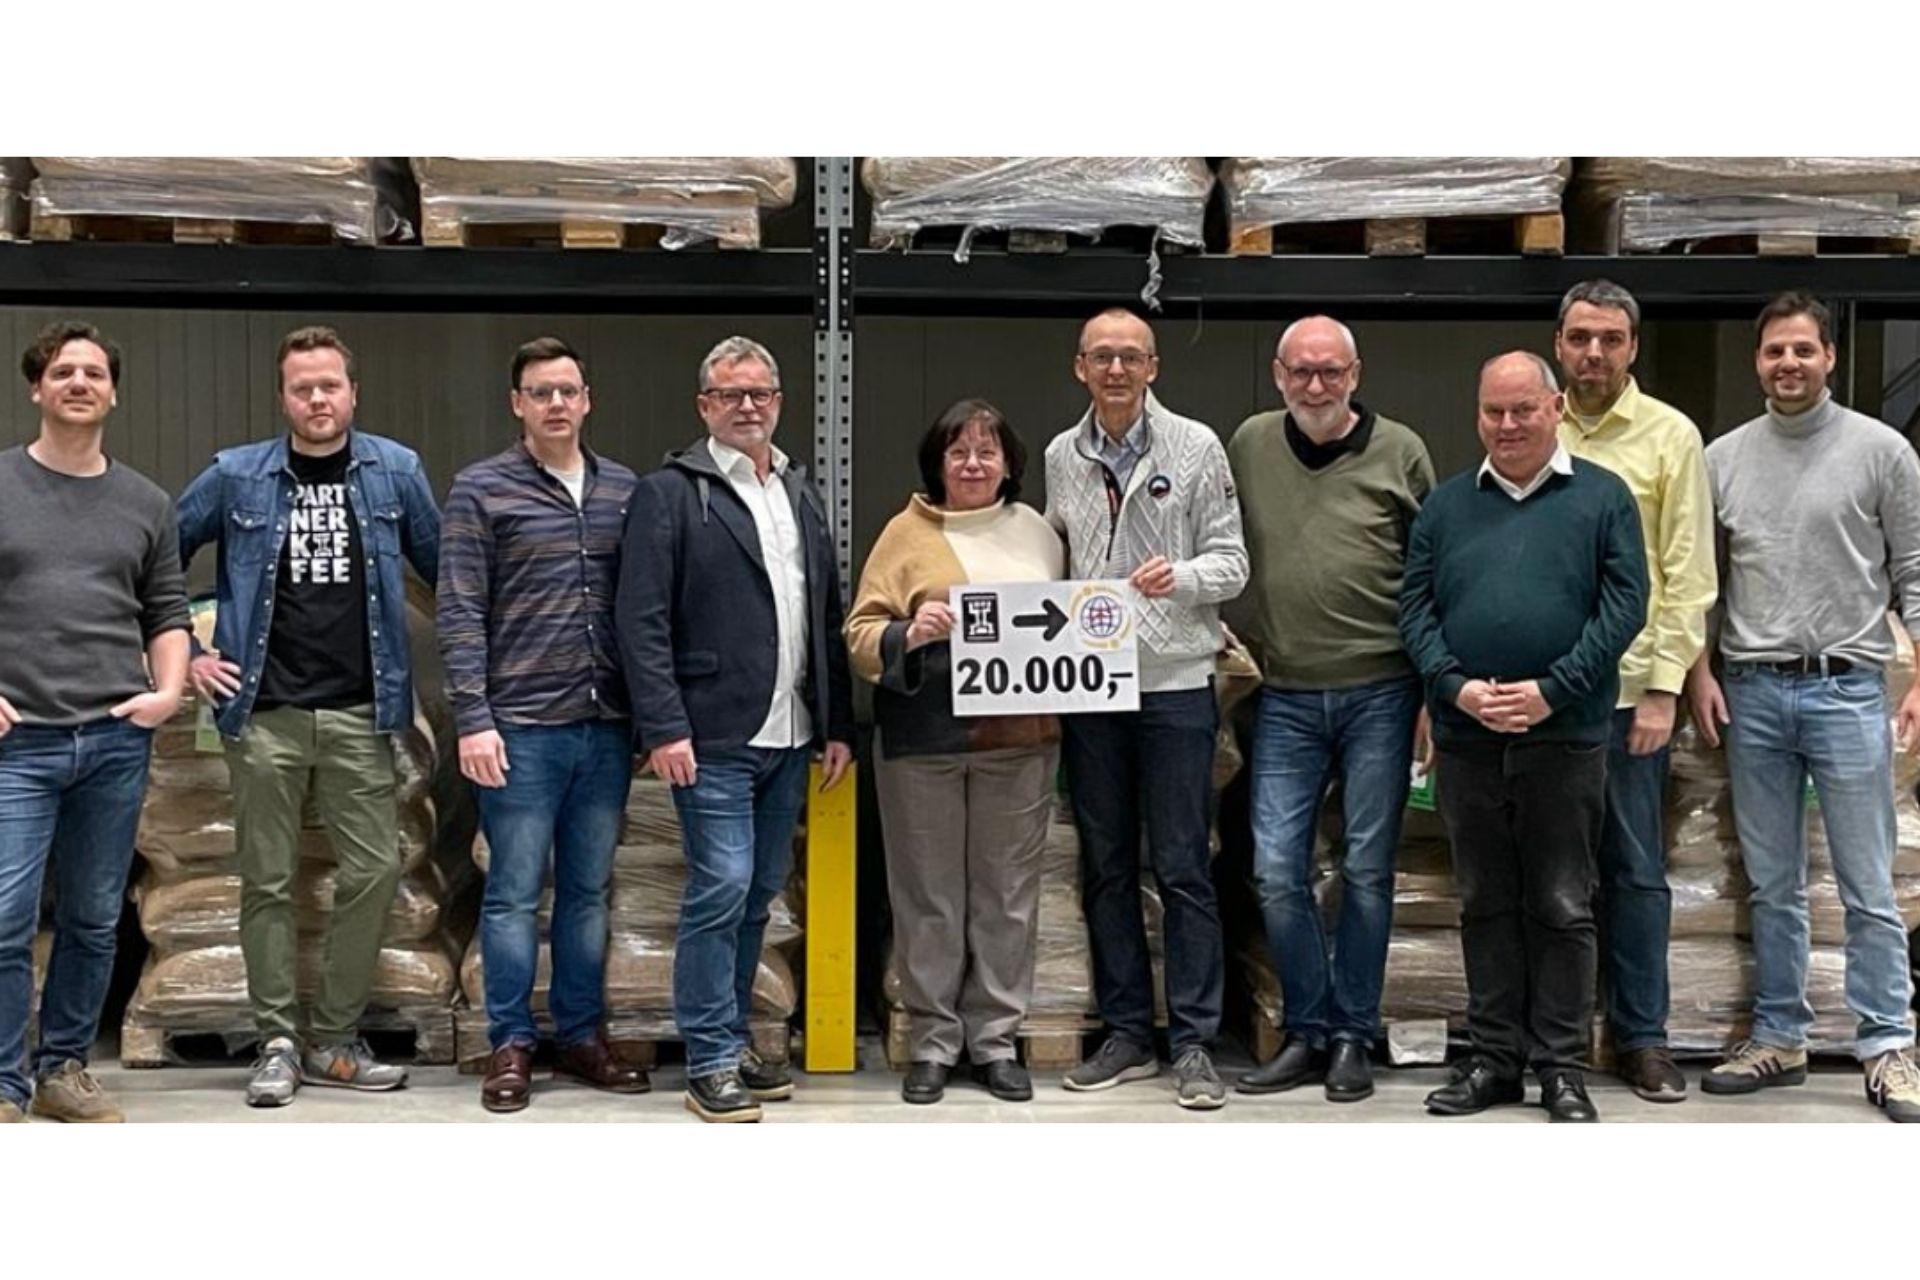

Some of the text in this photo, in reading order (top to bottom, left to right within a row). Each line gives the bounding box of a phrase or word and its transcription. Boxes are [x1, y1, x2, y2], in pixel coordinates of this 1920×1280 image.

[294, 484, 346, 507] PART
[291, 507, 349, 531] NER
[291, 558, 350, 583] FEE
